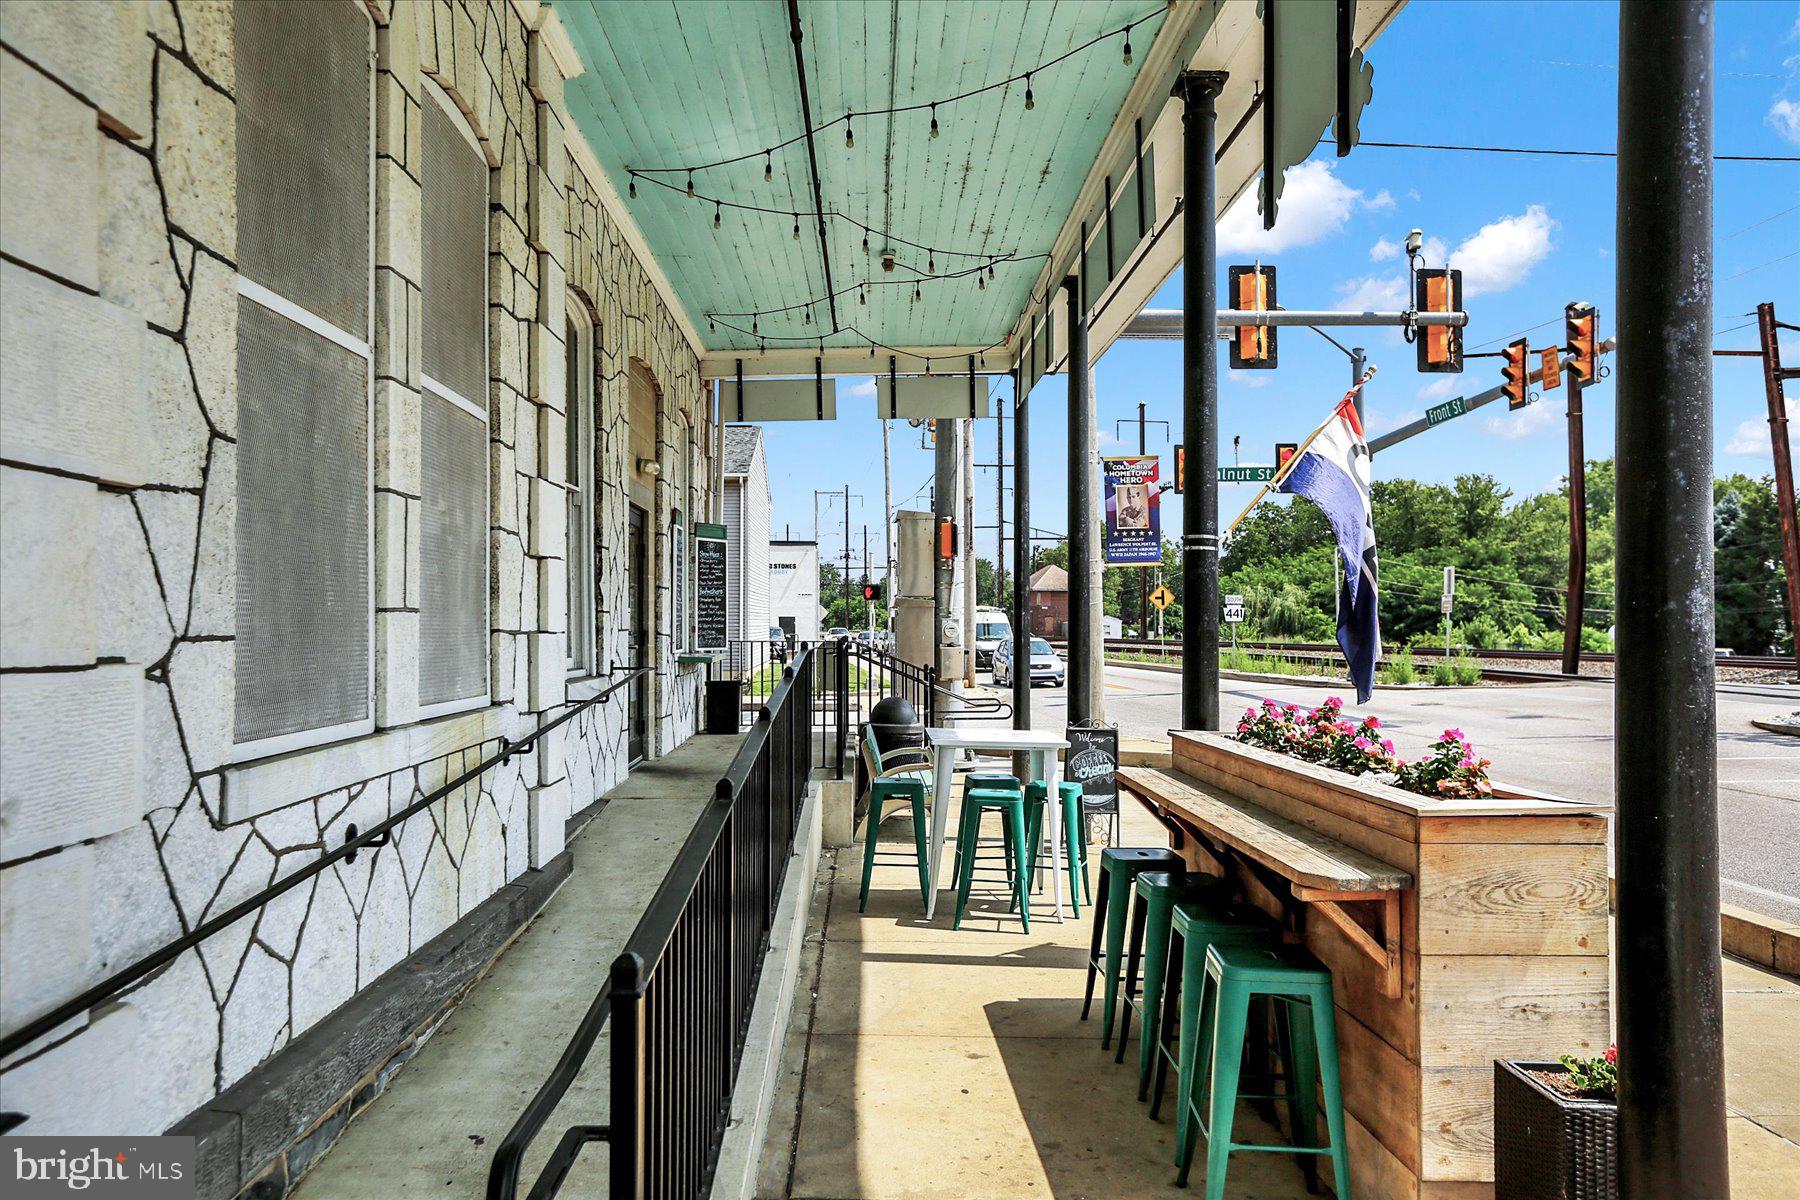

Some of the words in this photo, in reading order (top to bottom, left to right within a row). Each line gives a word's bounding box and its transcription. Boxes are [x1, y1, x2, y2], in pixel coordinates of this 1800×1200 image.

[1429, 404, 1451, 423] Front
[1452, 400, 1462, 414] St
[1257, 469, 1271, 480] St
[1226, 609, 1243, 618] 441
[1075, 733, 1114, 743] Welcome
